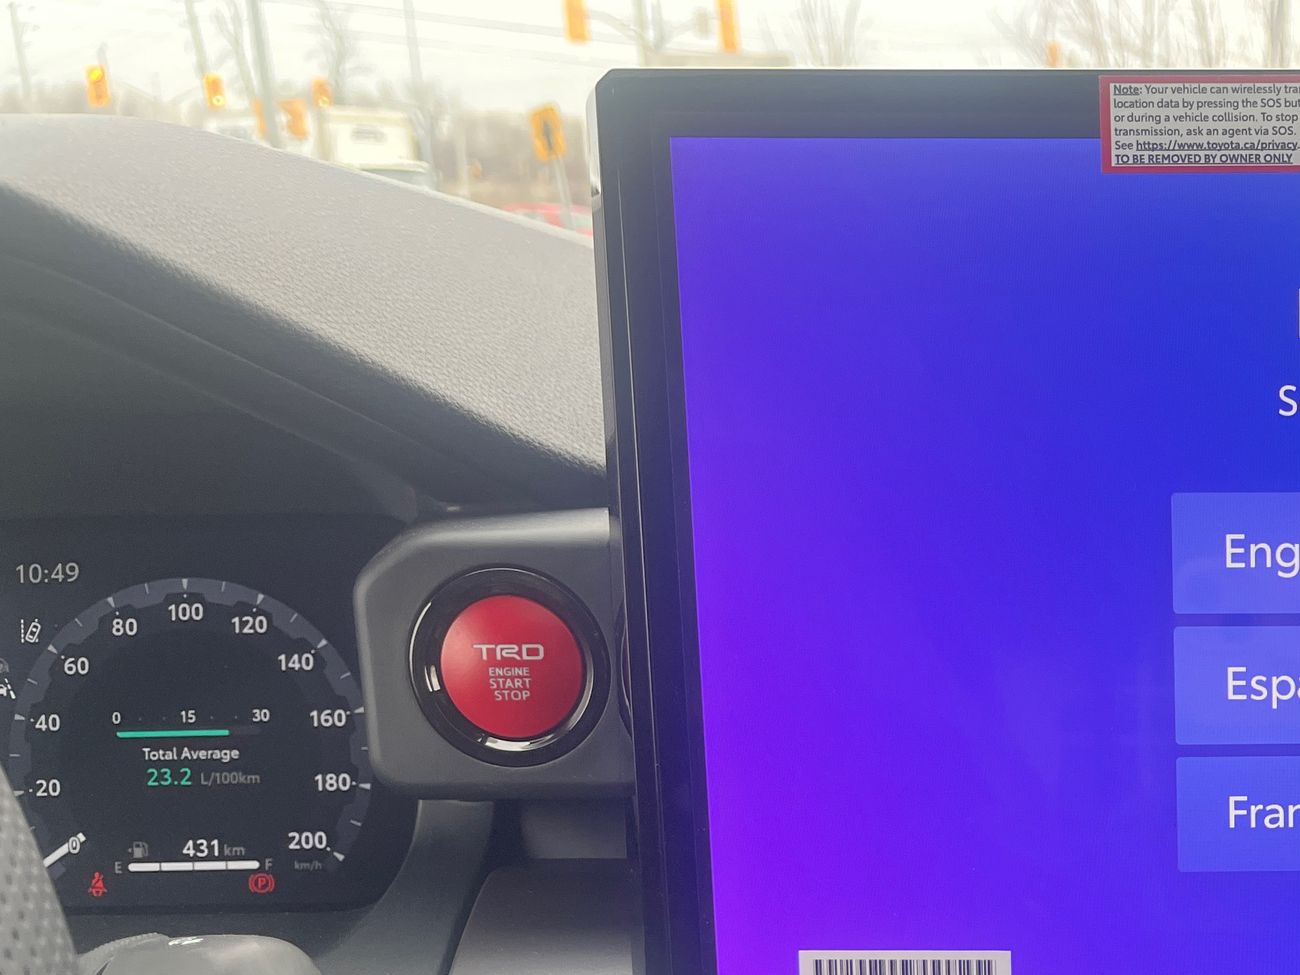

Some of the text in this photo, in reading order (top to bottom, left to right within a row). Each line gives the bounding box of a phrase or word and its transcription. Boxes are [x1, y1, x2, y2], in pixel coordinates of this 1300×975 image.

[1113, 84, 1143, 95] Note:
[1145, 84, 1168, 94] Your
[1170, 84, 1207, 94] vehicle
[1210, 86, 1228, 94] can
[1231, 84, 1281, 96] wirelessly
[1113, 98, 1154, 108] location
[1157, 98, 1180, 108] data
[1182, 98, 1194, 110] by
[1197, 99, 1239, 110] pressing
[1242, 98, 1258, 108] the
[1260, 98, 1282, 108] SOS
[1114, 112, 1298, 124] or during a vehicle collision. To stop
[1115, 126, 1183, 137] transmission,
[1186, 126, 1203, 135] ask
[1221, 126, 1252, 138] agent
[1254, 126, 1269, 135] via
[1272, 126, 1296, 135] SOS.
[1115, 139, 1300, 151] See https://www.toyota.ca/privacy.
[1115, 153, 1293, 165] TO BE REMOVED BY OWNER ONLY
[15, 562, 79, 584] 10:49
[167, 603, 204, 622] 100
[111, 618, 138, 636] 80
[231, 616, 268, 635] 120
[473, 644, 545, 661] TRD
[63, 657, 90, 675] 60
[277, 652, 314, 671] 140
[488, 667, 530, 677] ENGINE
[489, 678, 532, 689] START
[494, 690, 530, 701] STOP
[35, 713, 61, 732] 40
[111, 711, 122, 725] 0
[180, 710, 197, 724] 15
[252, 709, 270, 723] 30
[309, 709, 347, 728] 160
[142, 747, 240, 762] Total Average
[146, 768, 261, 786] 23.2 L/100km
[314, 773, 350, 792] 180
[35, 779, 61, 797] 20
[68, 836, 81, 854] 0
[182, 839, 246, 857] 431 km
[288, 832, 327, 850] 200
[114, 861, 123, 874] E
[264, 858, 273, 871] F
[294, 859, 323, 871] km/h
